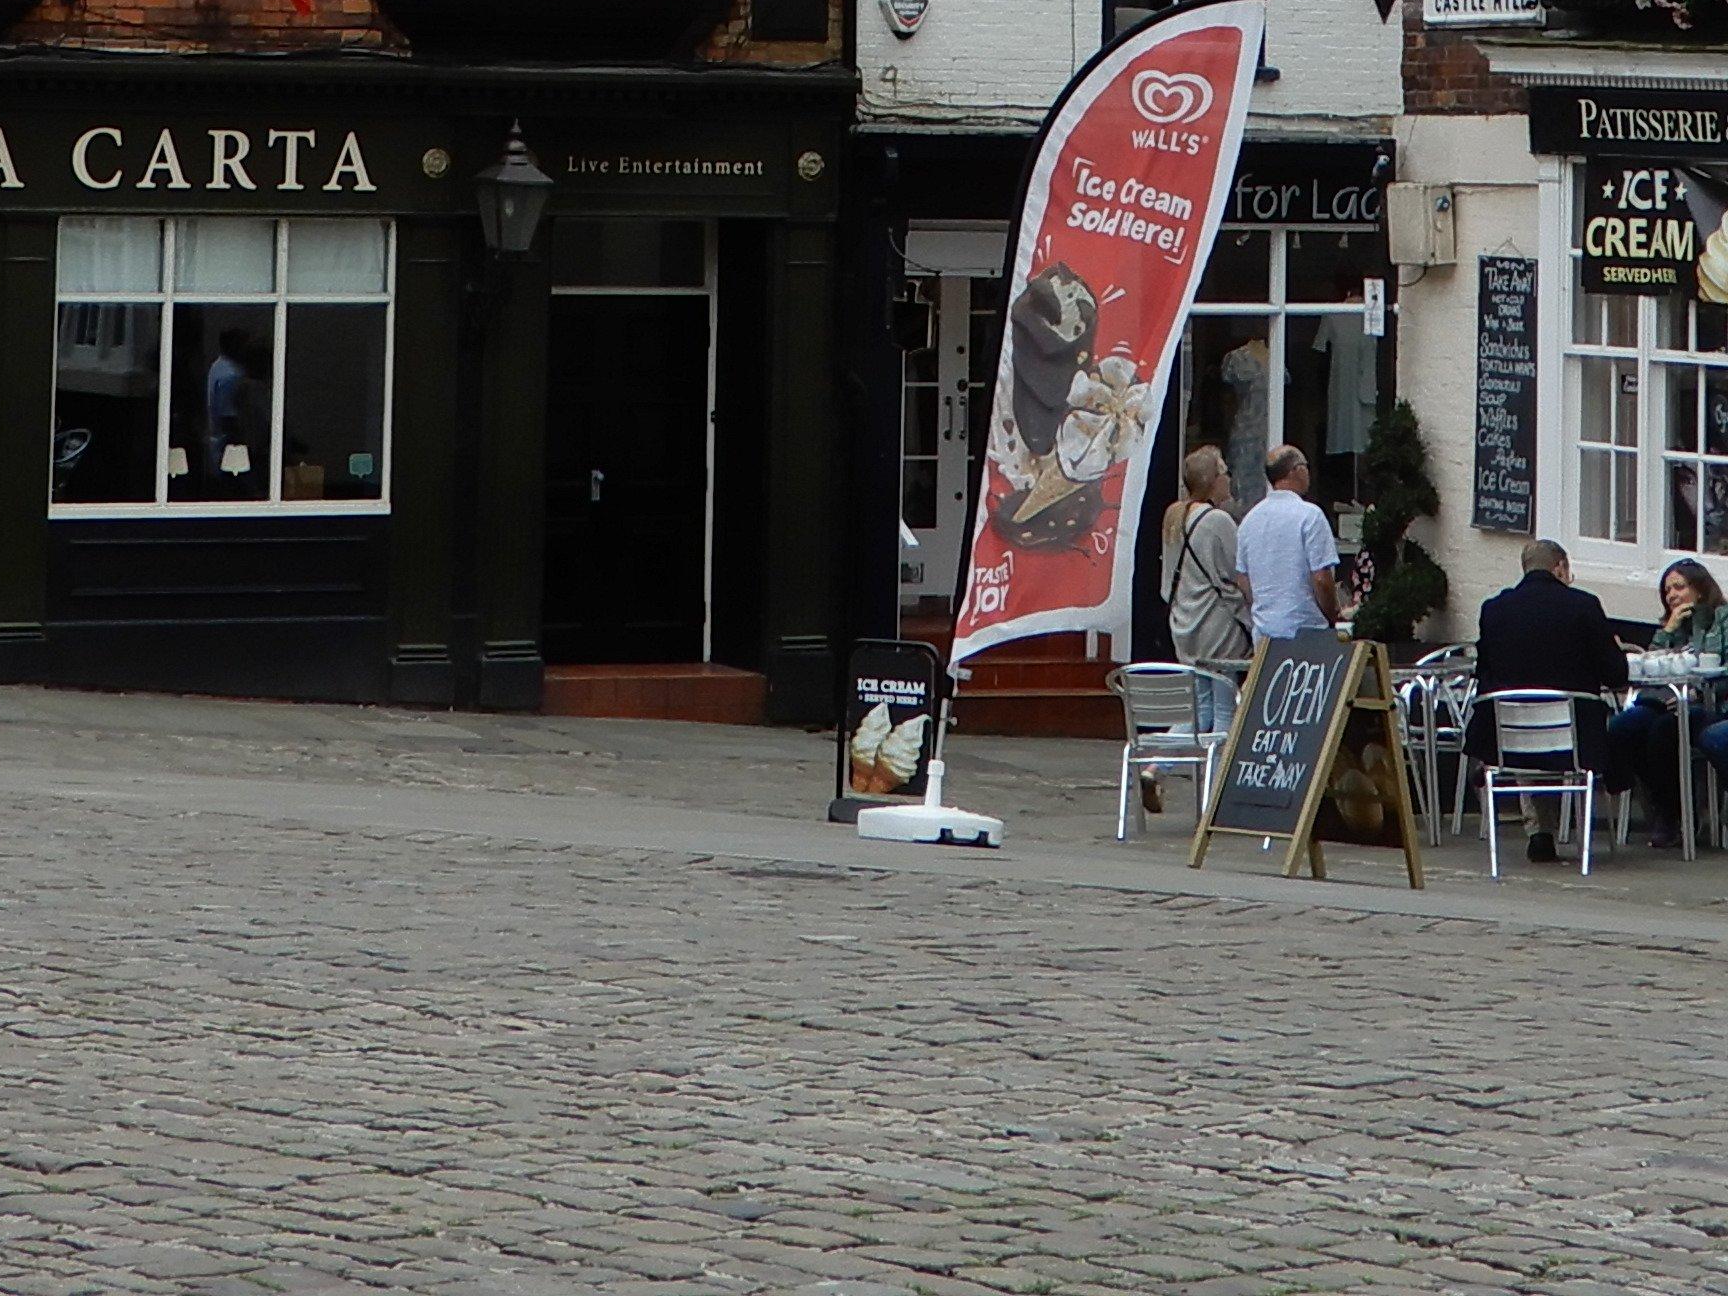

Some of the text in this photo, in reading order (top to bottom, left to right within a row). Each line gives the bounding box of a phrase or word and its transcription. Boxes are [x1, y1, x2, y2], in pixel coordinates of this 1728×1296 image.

[1131, 129, 1200, 156] WALL'S
[72, 127, 378, 193] CARTA
[567, 156, 764, 176] Live Entertainment
[1076, 168, 1192, 221] Ice Cream
[1235, 173, 1300, 220] for
[1618, 170, 1670, 210] ICE
[1066, 202, 1122, 237] Sold
[1586, 216, 1694, 262] CREAM
[1603, 266, 1651, 284] SERVED
[974, 584, 1010, 614] JOY
[857, 677, 925, 696] ICE CREAM
[1262, 654, 1344, 727] OPEN
[1252, 729, 1299, 755] EAT IN
[1236, 760, 1271, 788] TAKE
